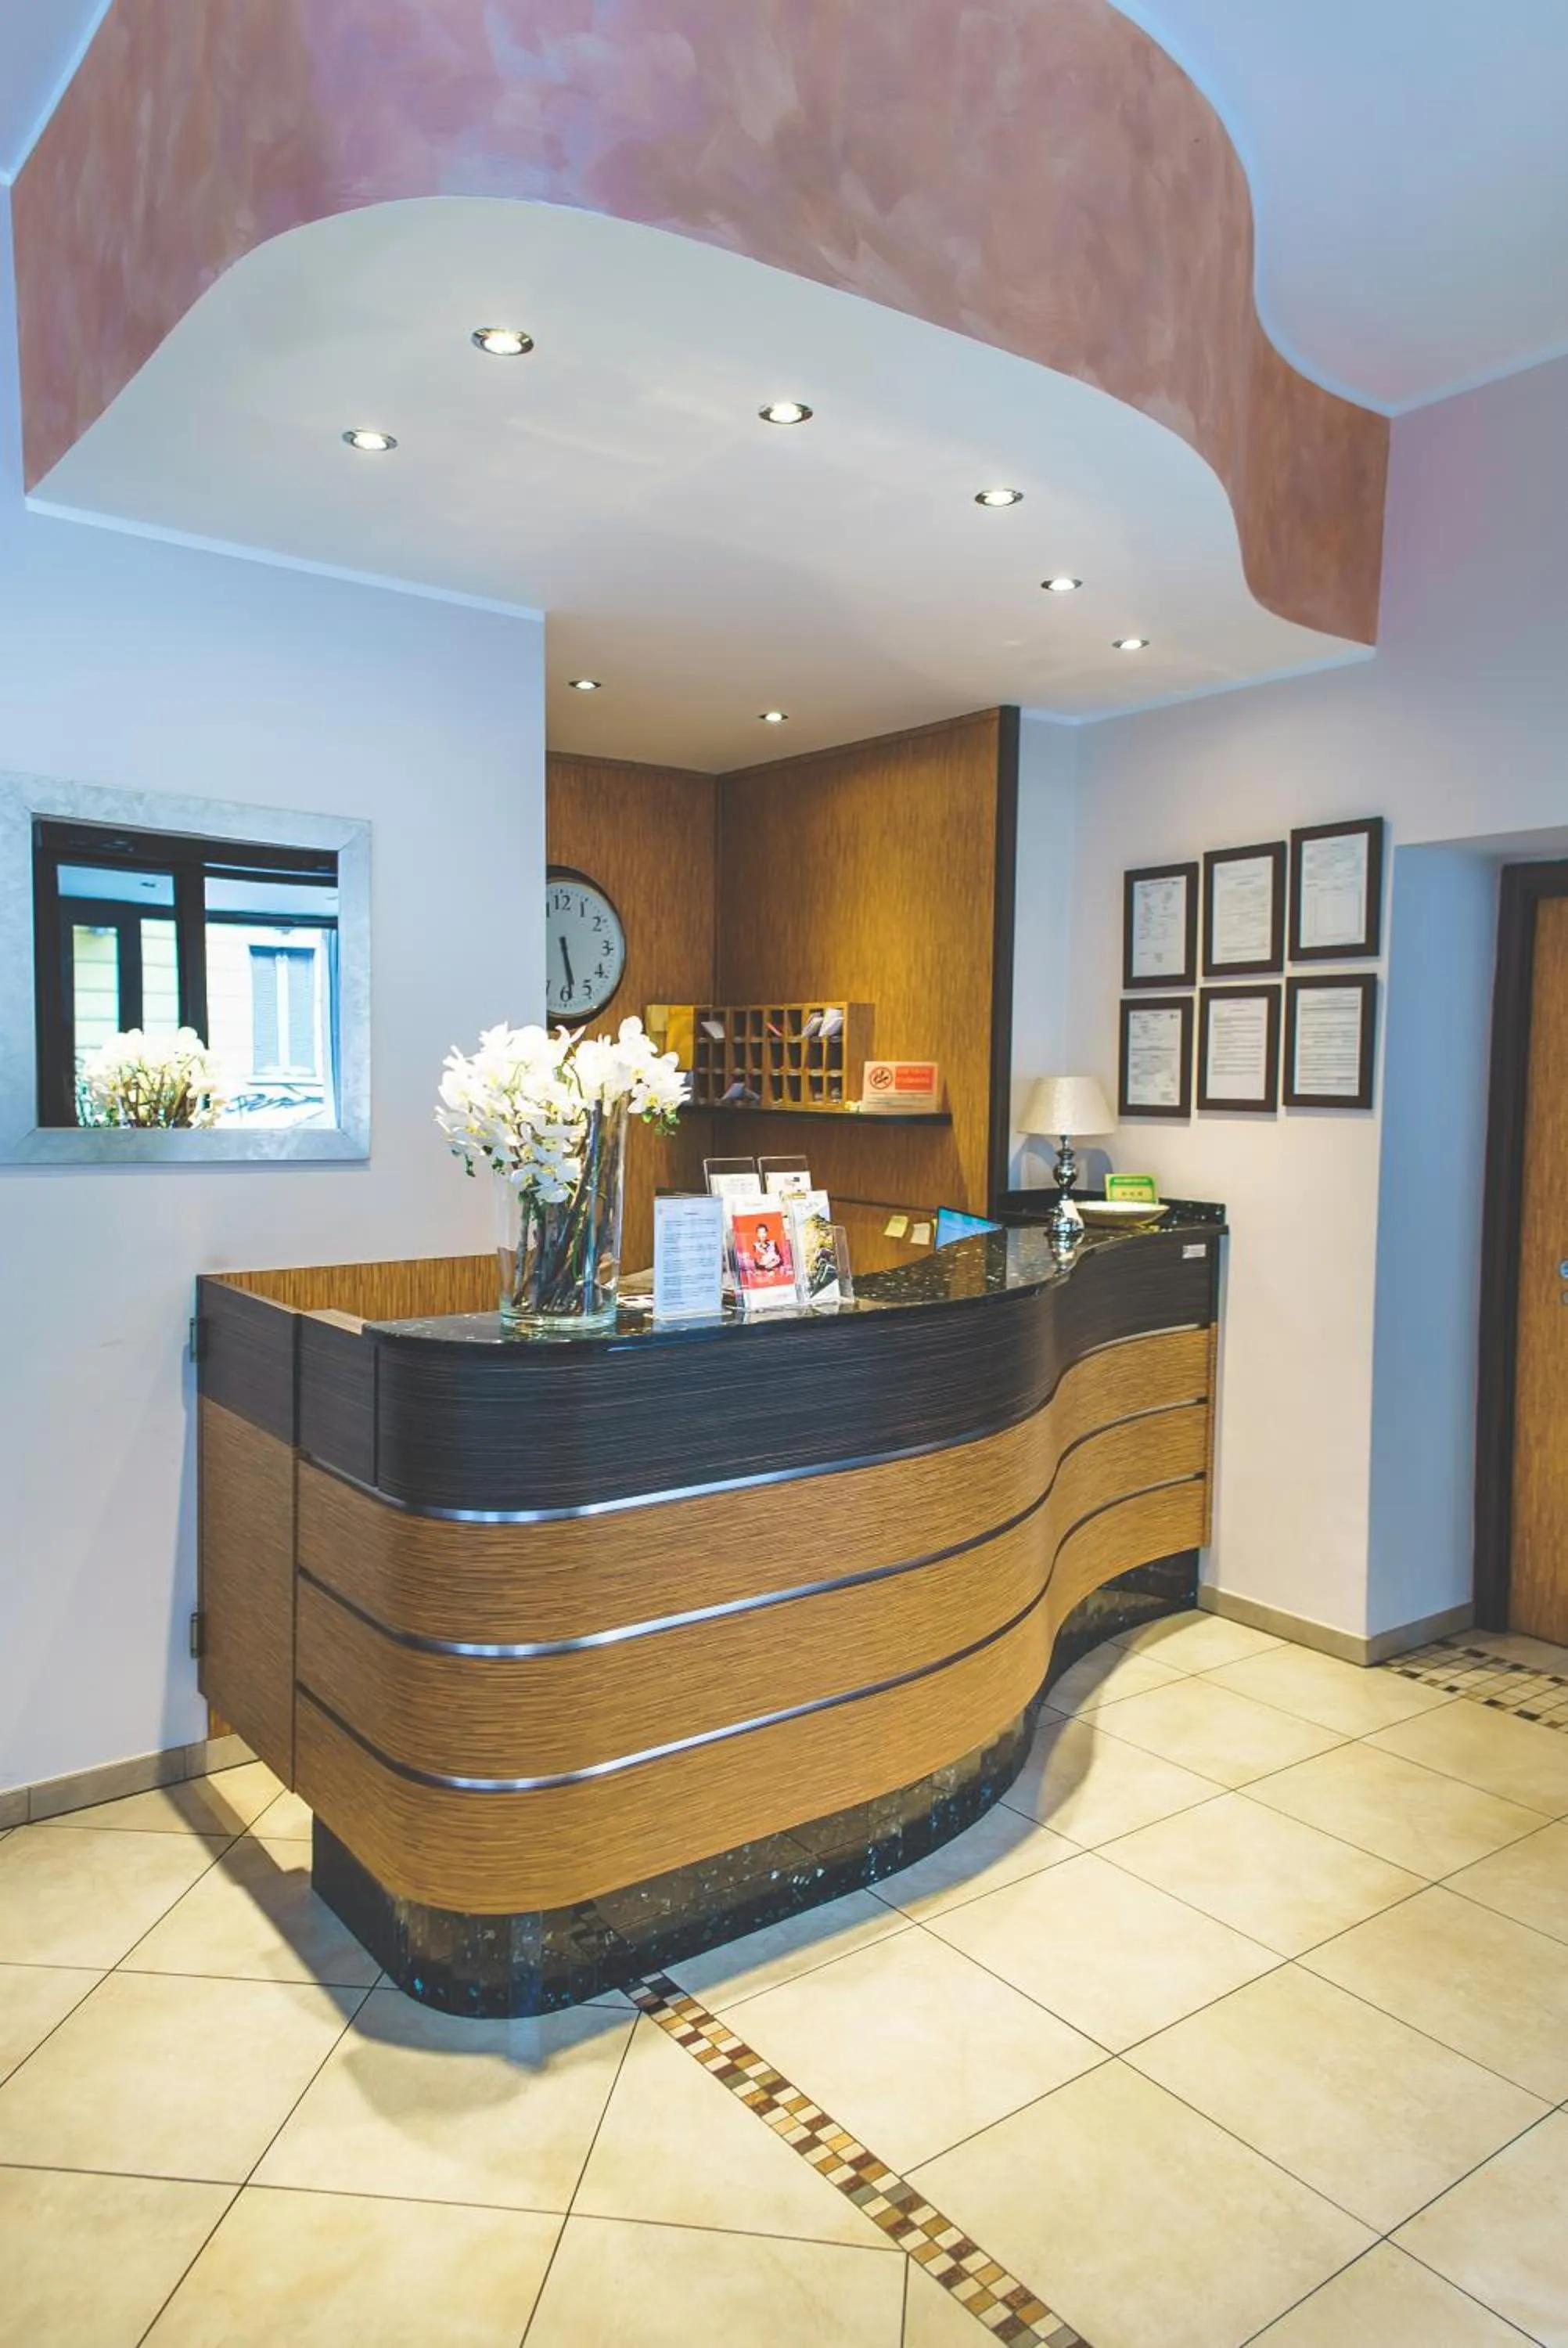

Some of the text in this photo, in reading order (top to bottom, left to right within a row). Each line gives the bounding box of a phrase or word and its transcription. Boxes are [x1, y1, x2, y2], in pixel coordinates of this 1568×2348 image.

[554, 895, 570, 910] 12
[580, 901, 585, 917] 1
[592, 917, 602, 931] 2
[601, 940, 610, 956] 3
[595, 962, 604, 978] 4
[559, 985, 573, 1002] 6
[582, 979, 592, 996] 5
